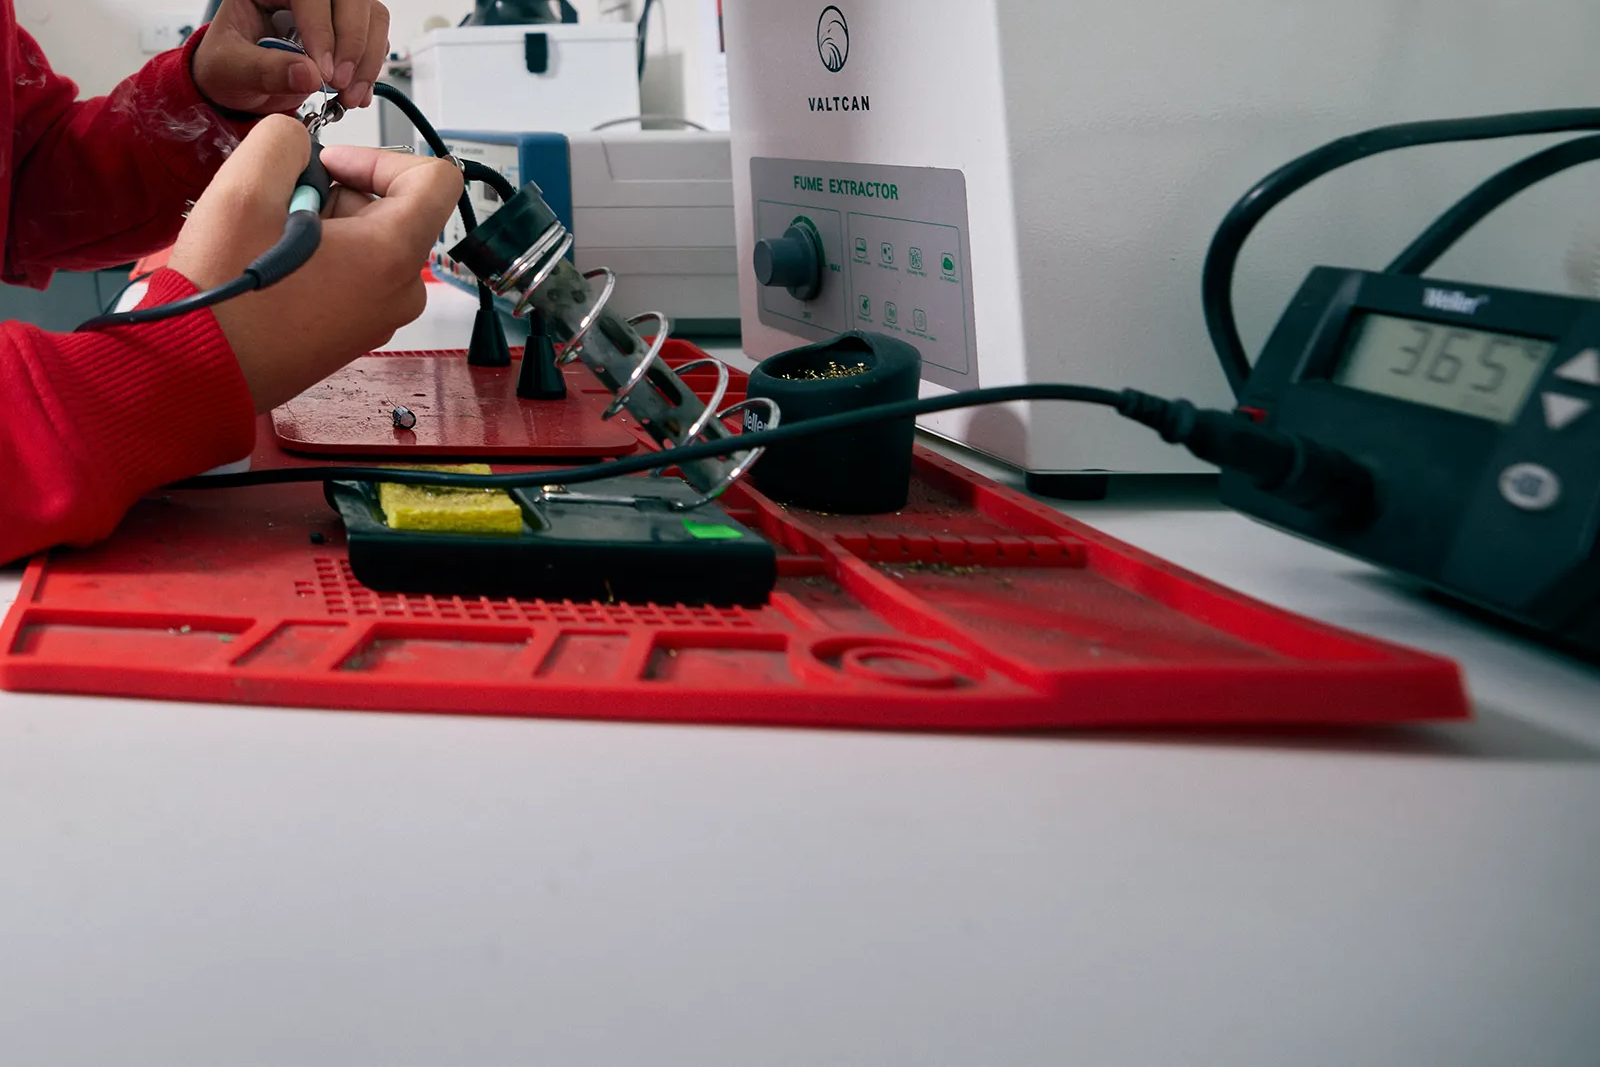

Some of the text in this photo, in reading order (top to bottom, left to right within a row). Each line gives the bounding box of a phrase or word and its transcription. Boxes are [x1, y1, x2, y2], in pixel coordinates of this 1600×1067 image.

[808, 95, 870, 112] VALTCAN
[793, 175, 899, 201] FUME EXTRACTOR
[1390, 323, 1514, 393] 365
